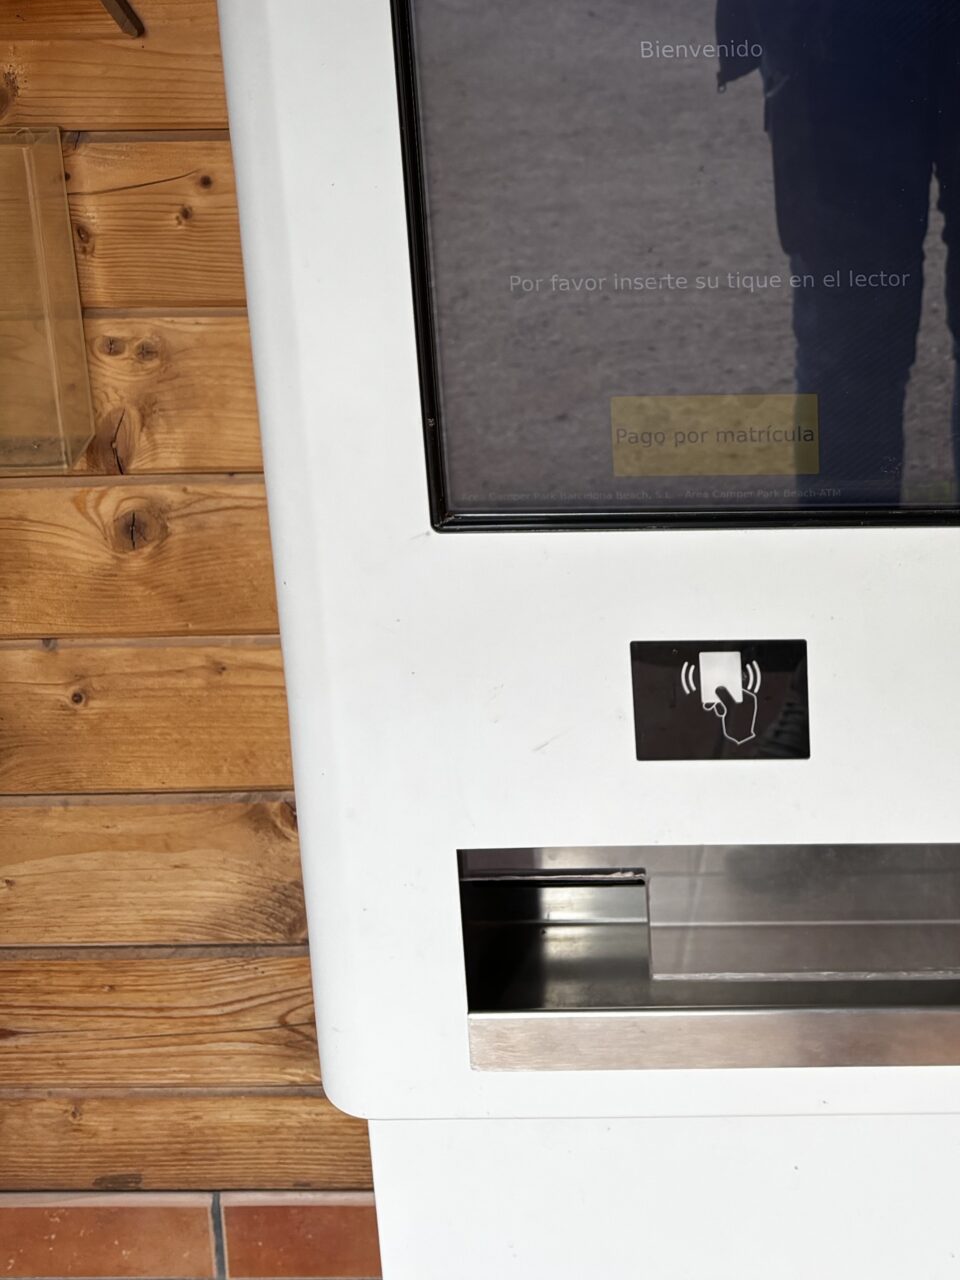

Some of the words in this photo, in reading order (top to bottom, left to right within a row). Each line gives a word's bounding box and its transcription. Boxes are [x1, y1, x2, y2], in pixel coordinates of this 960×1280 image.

[640, 39, 763, 59] Bienvenido
[510, 275, 543, 292] Por
[551, 274, 607, 291] favor
[614, 273, 688, 290] inserte
[696, 276, 718, 289] su
[727, 272, 781, 293] tique
[789, 274, 815, 288] en
[823, 270, 840, 287] el
[849, 270, 910, 287] lector
[616, 428, 665, 447] Pago
[674, 430, 709, 448] por
[716, 424, 815, 443] matrícula
